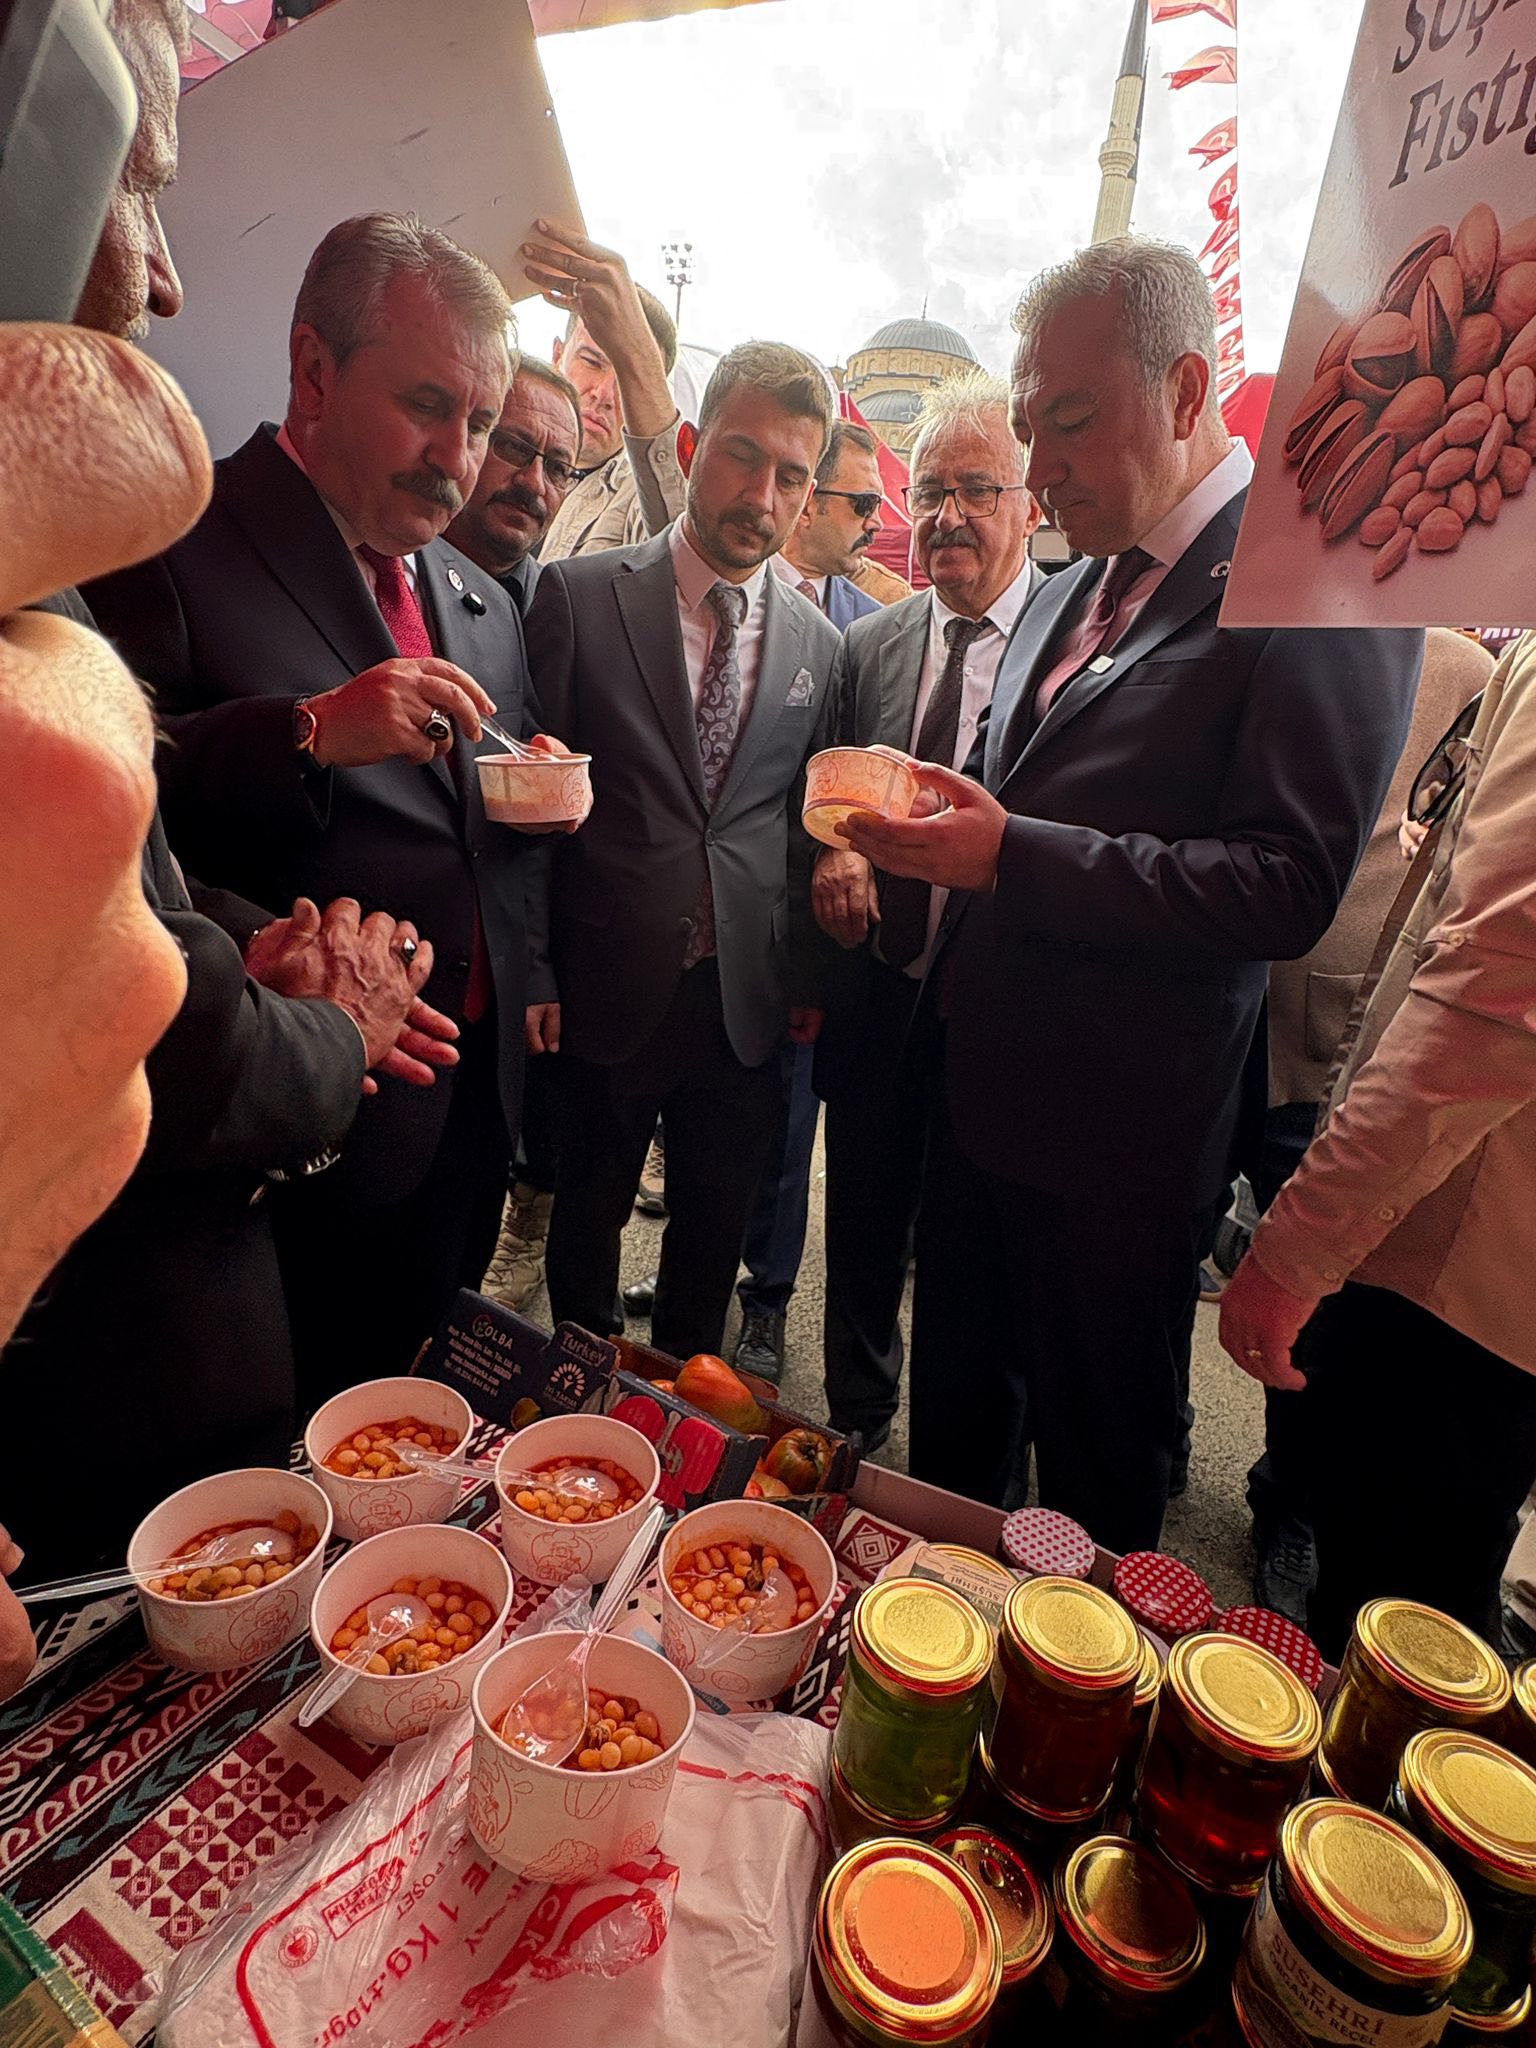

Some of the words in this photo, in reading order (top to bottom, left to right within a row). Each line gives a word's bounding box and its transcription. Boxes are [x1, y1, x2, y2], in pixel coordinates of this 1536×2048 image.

[1388, 49, 1536, 190] Fıstı
[562, 1331, 607, 1367] Turkey
[397, 1861, 446, 1920] POŞET
